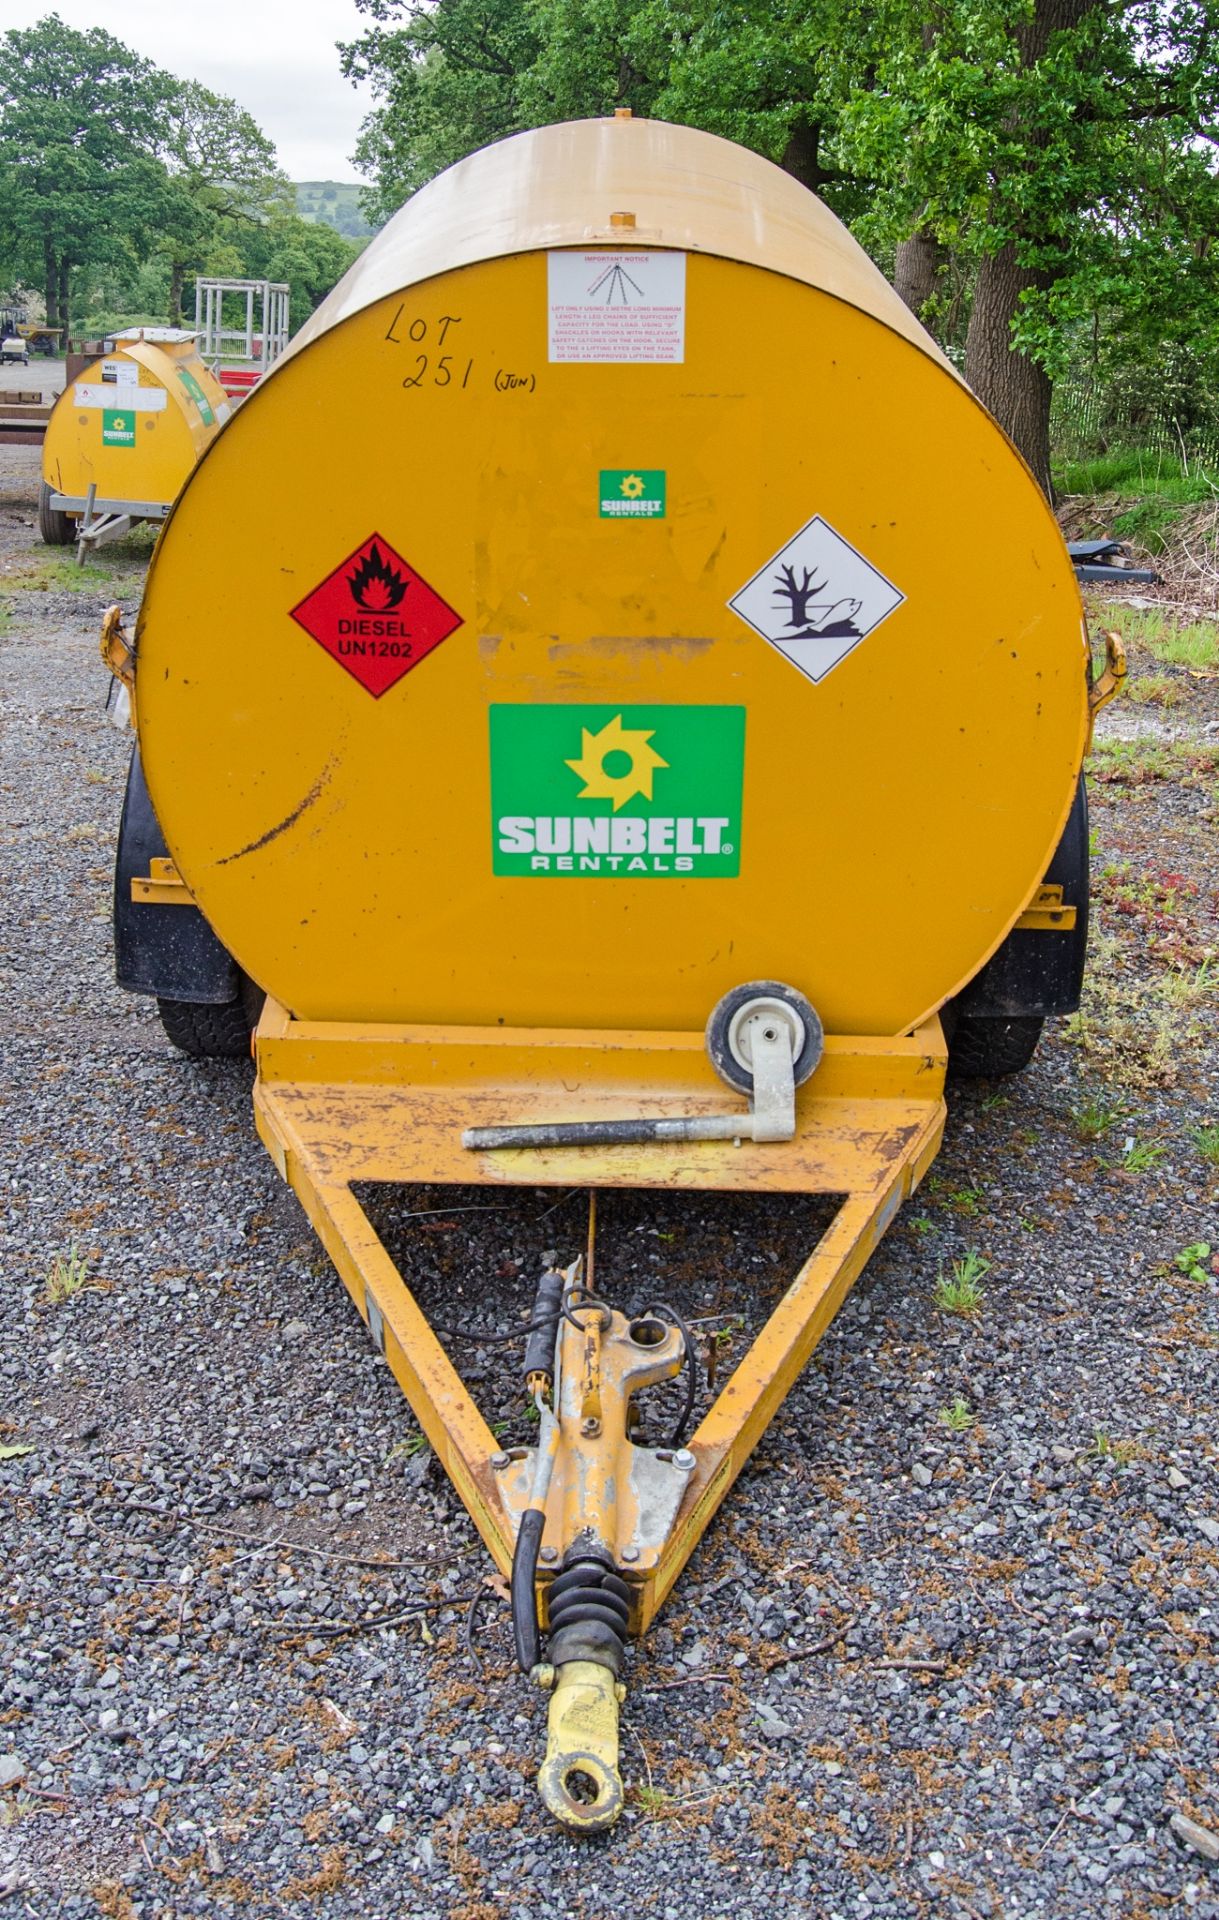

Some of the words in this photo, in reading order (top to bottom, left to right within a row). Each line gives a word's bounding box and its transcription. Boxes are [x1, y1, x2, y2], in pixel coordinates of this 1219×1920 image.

[385, 303, 462, 346] LOT
[402, 354, 473, 389] 251
[494, 369, 536, 393] (JUN)
[601, 500, 662, 512] SUNBELT
[338, 619, 412, 637] DIESEL
[338, 640, 413, 658] UN1202
[531, 856, 694, 871] RENTALS
